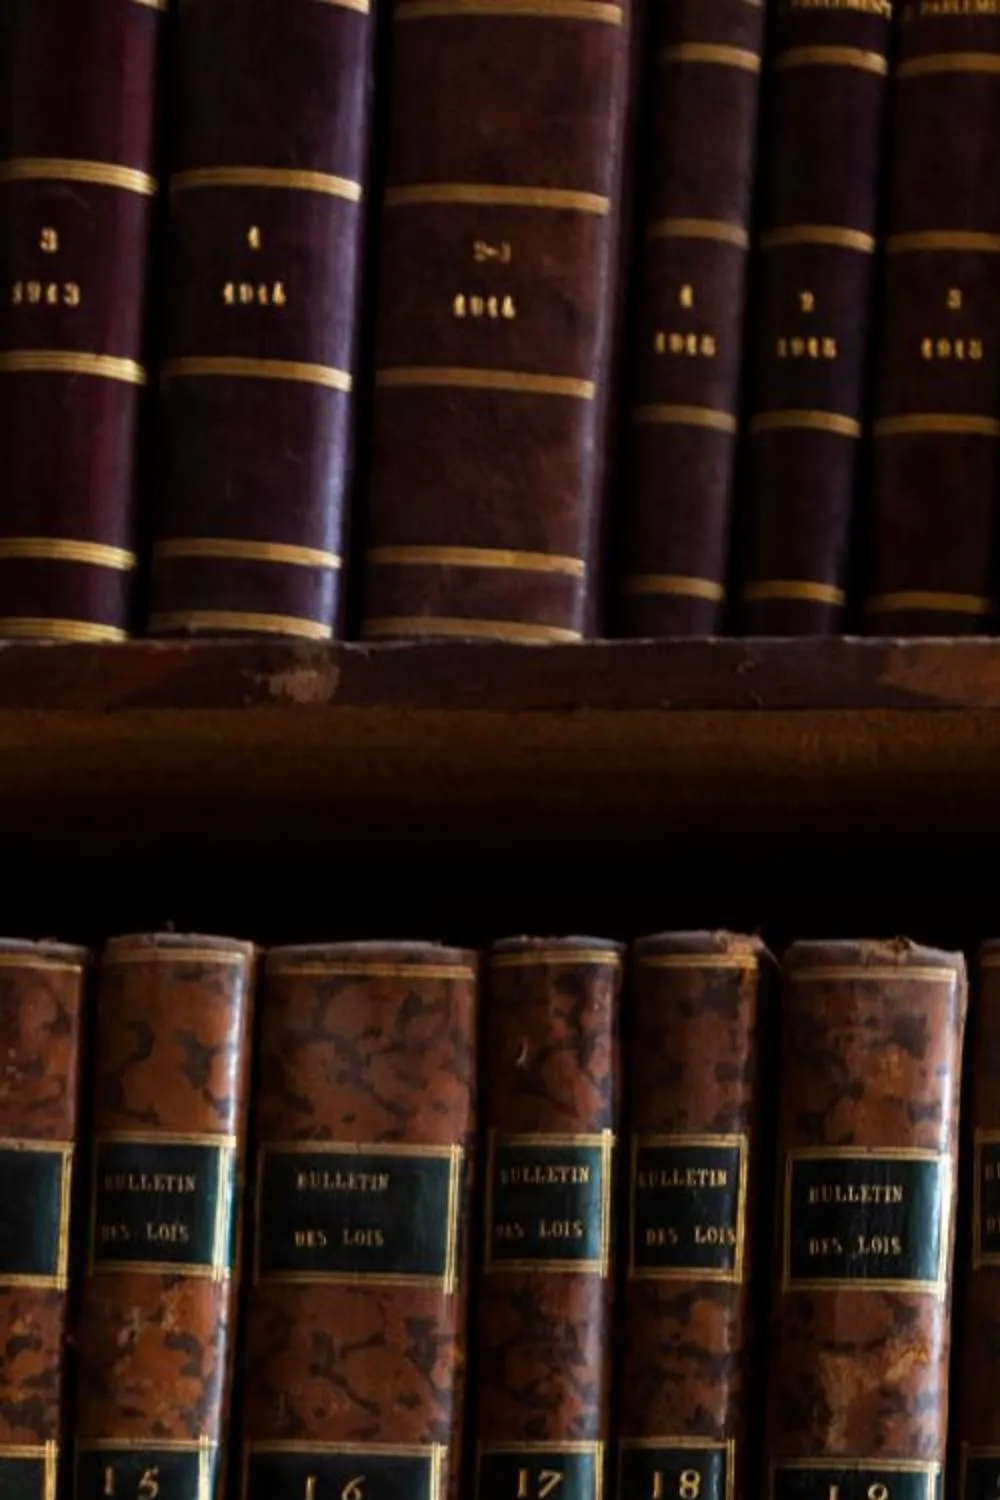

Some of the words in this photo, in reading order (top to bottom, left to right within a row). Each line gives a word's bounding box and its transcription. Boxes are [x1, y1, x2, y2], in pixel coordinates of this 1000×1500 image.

[297, 1172, 389, 1192] BULLETIN
[809, 1185, 903, 1204] BULLETIN
[294, 1228, 327, 1248] DES
[343, 1227, 384, 1247] LOIS
[809, 1238, 842, 1255] DES
[857, 1236, 901, 1255] LOIS
[517, 1469, 563, 1500] 17
[651, 1468, 701, 1500] 18
